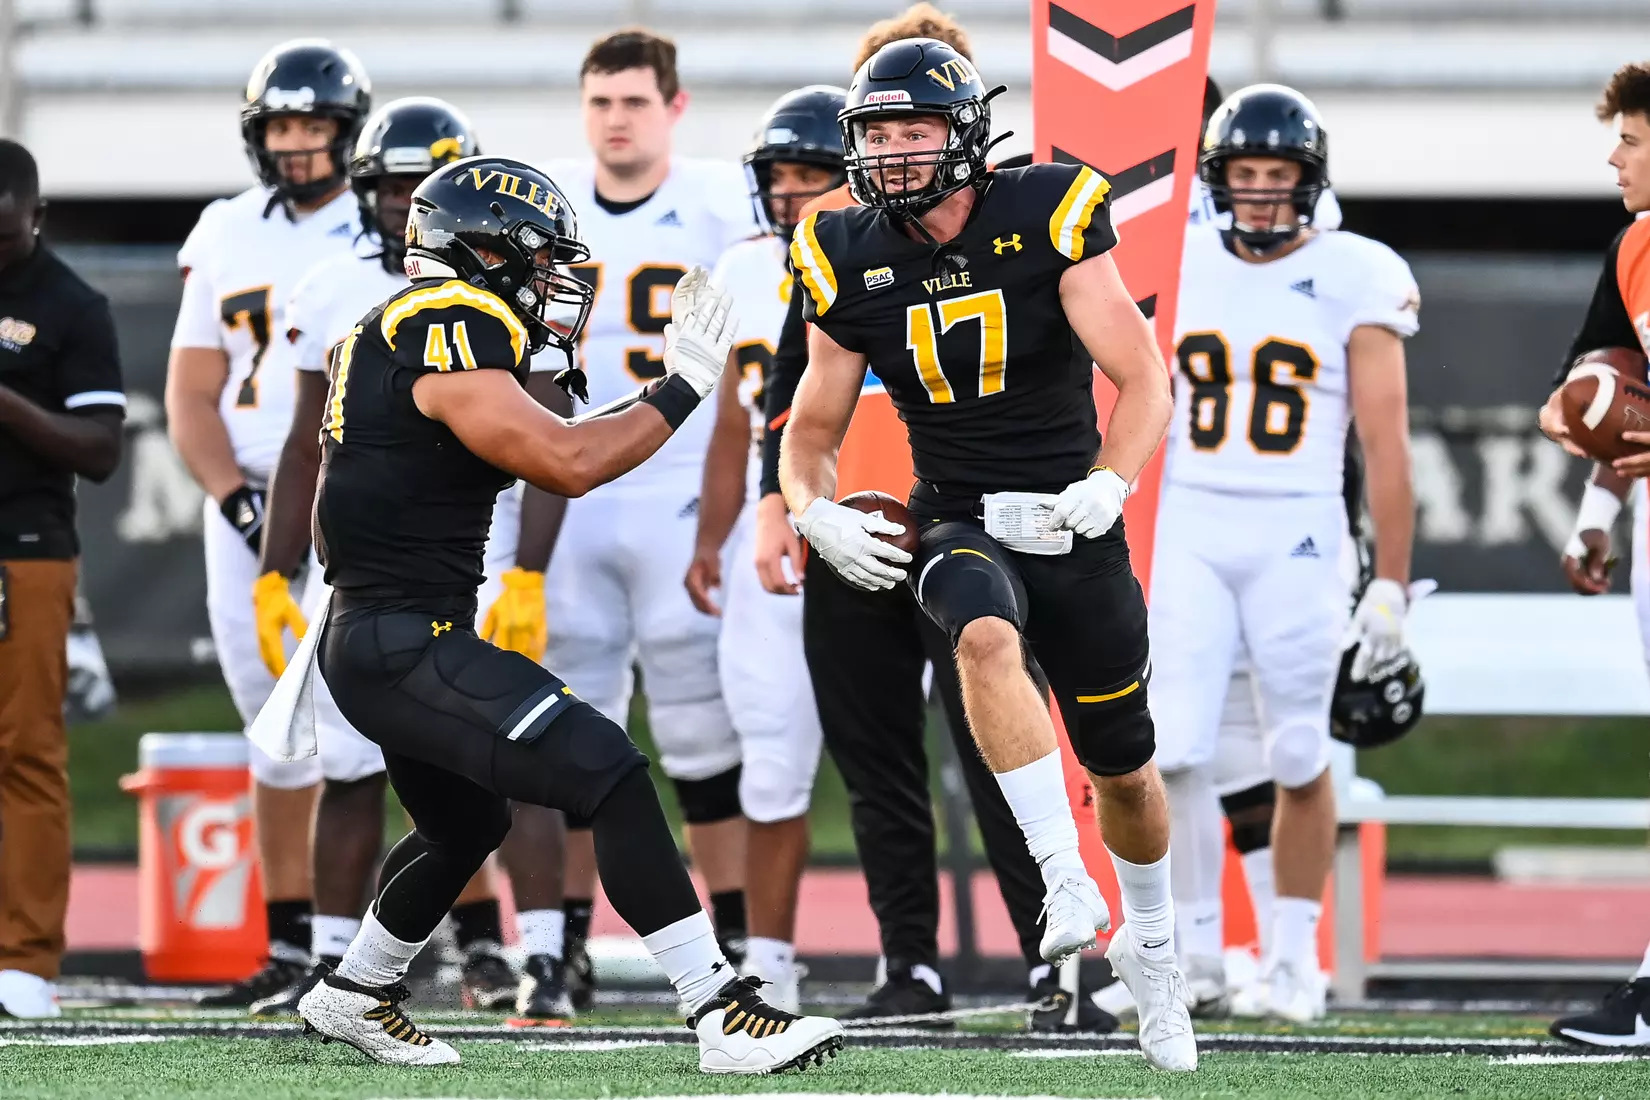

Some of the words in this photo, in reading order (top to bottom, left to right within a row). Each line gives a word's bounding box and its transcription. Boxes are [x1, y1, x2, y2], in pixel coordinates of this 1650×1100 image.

[868, 93, 905, 104] Riddell
[468, 168, 561, 220] VILLE
[405, 259, 421, 276] ell
[866, 271, 892, 285] PSAC
[220, 285, 273, 410] 7
[424, 320, 478, 372] 41
[906, 289, 1008, 404] 17
[1175, 330, 1321, 455] 86
[182, 801, 238, 868] G
